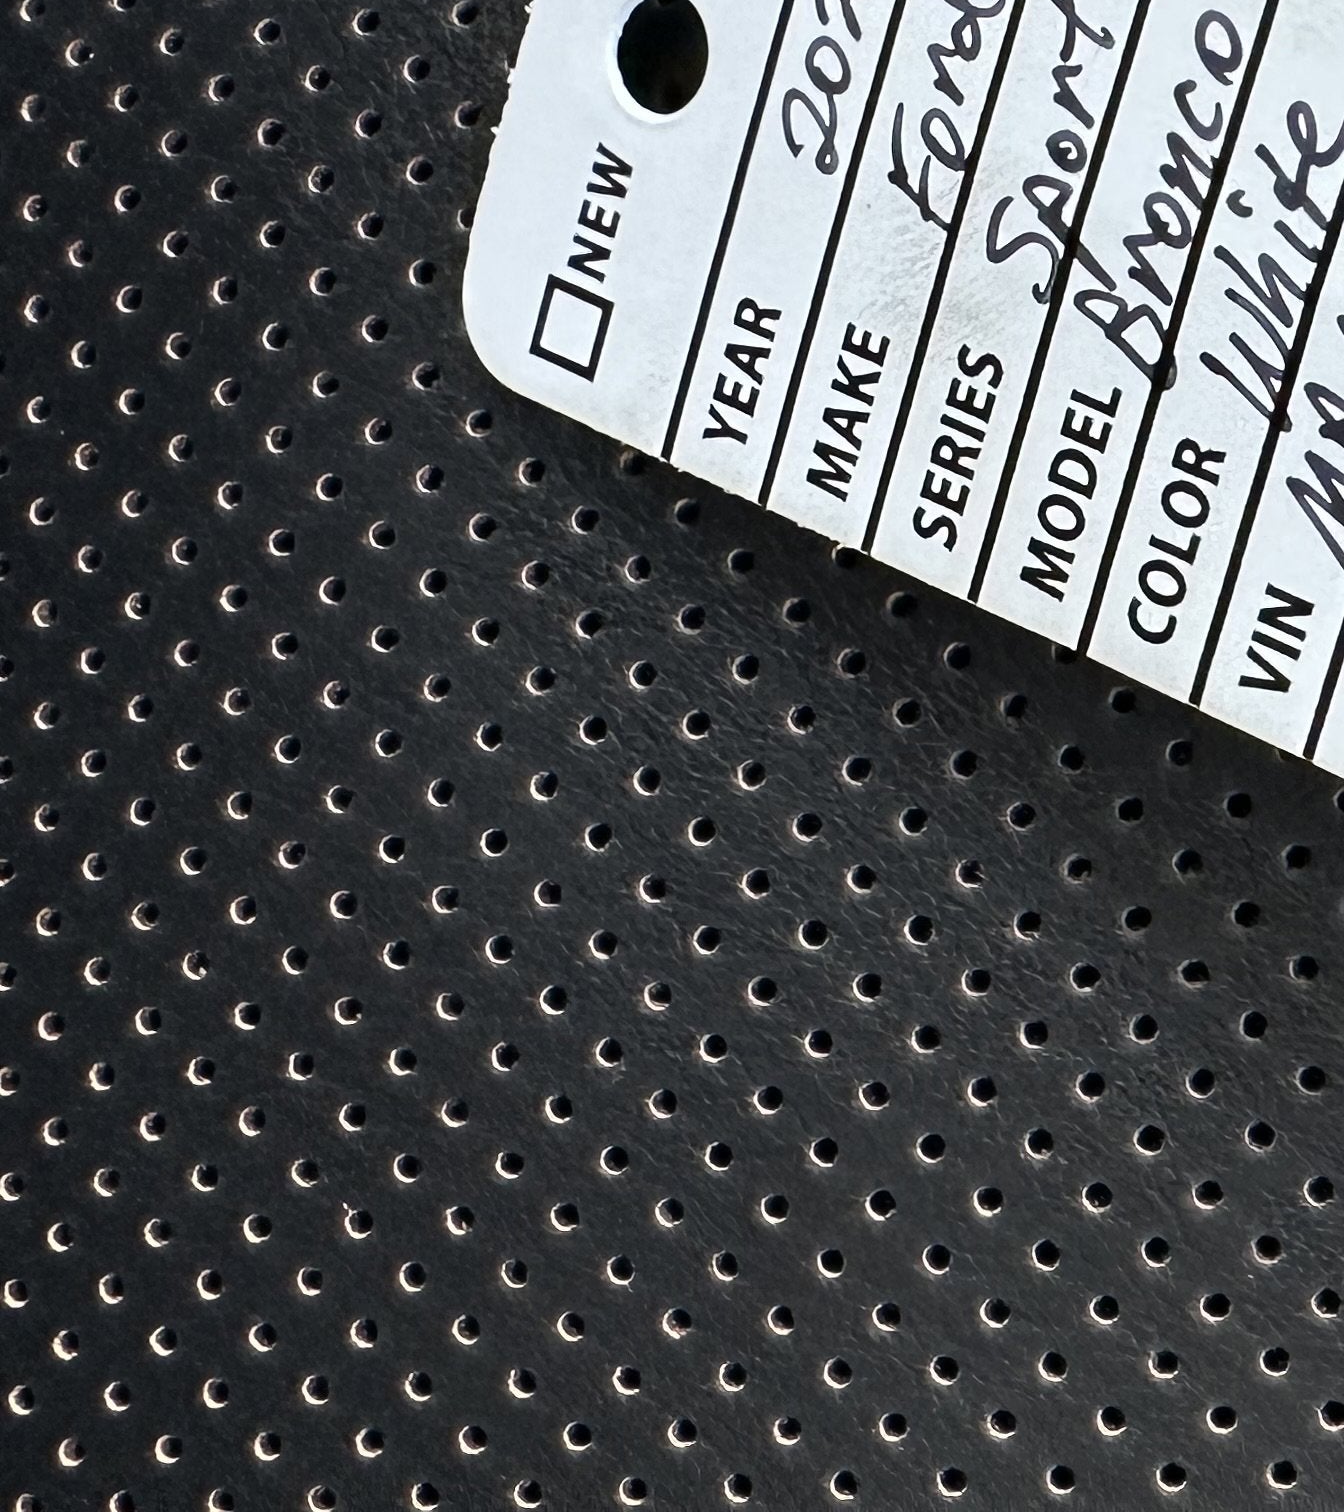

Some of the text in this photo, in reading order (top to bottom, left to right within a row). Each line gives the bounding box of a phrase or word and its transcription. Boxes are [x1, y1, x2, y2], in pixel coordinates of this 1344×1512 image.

[567, 143, 633, 283] NEW
[1074, 10, 1243, 389] Bronco
[702, 297, 781, 445] YEAR
[807, 323, 891, 501] MAKE
[913, 345, 1002, 550] SERIES
[1021, 386, 1121, 602] MODEL
[1128, 438, 1226, 645] COLOR
[1239, 583, 1314, 693] VIN
